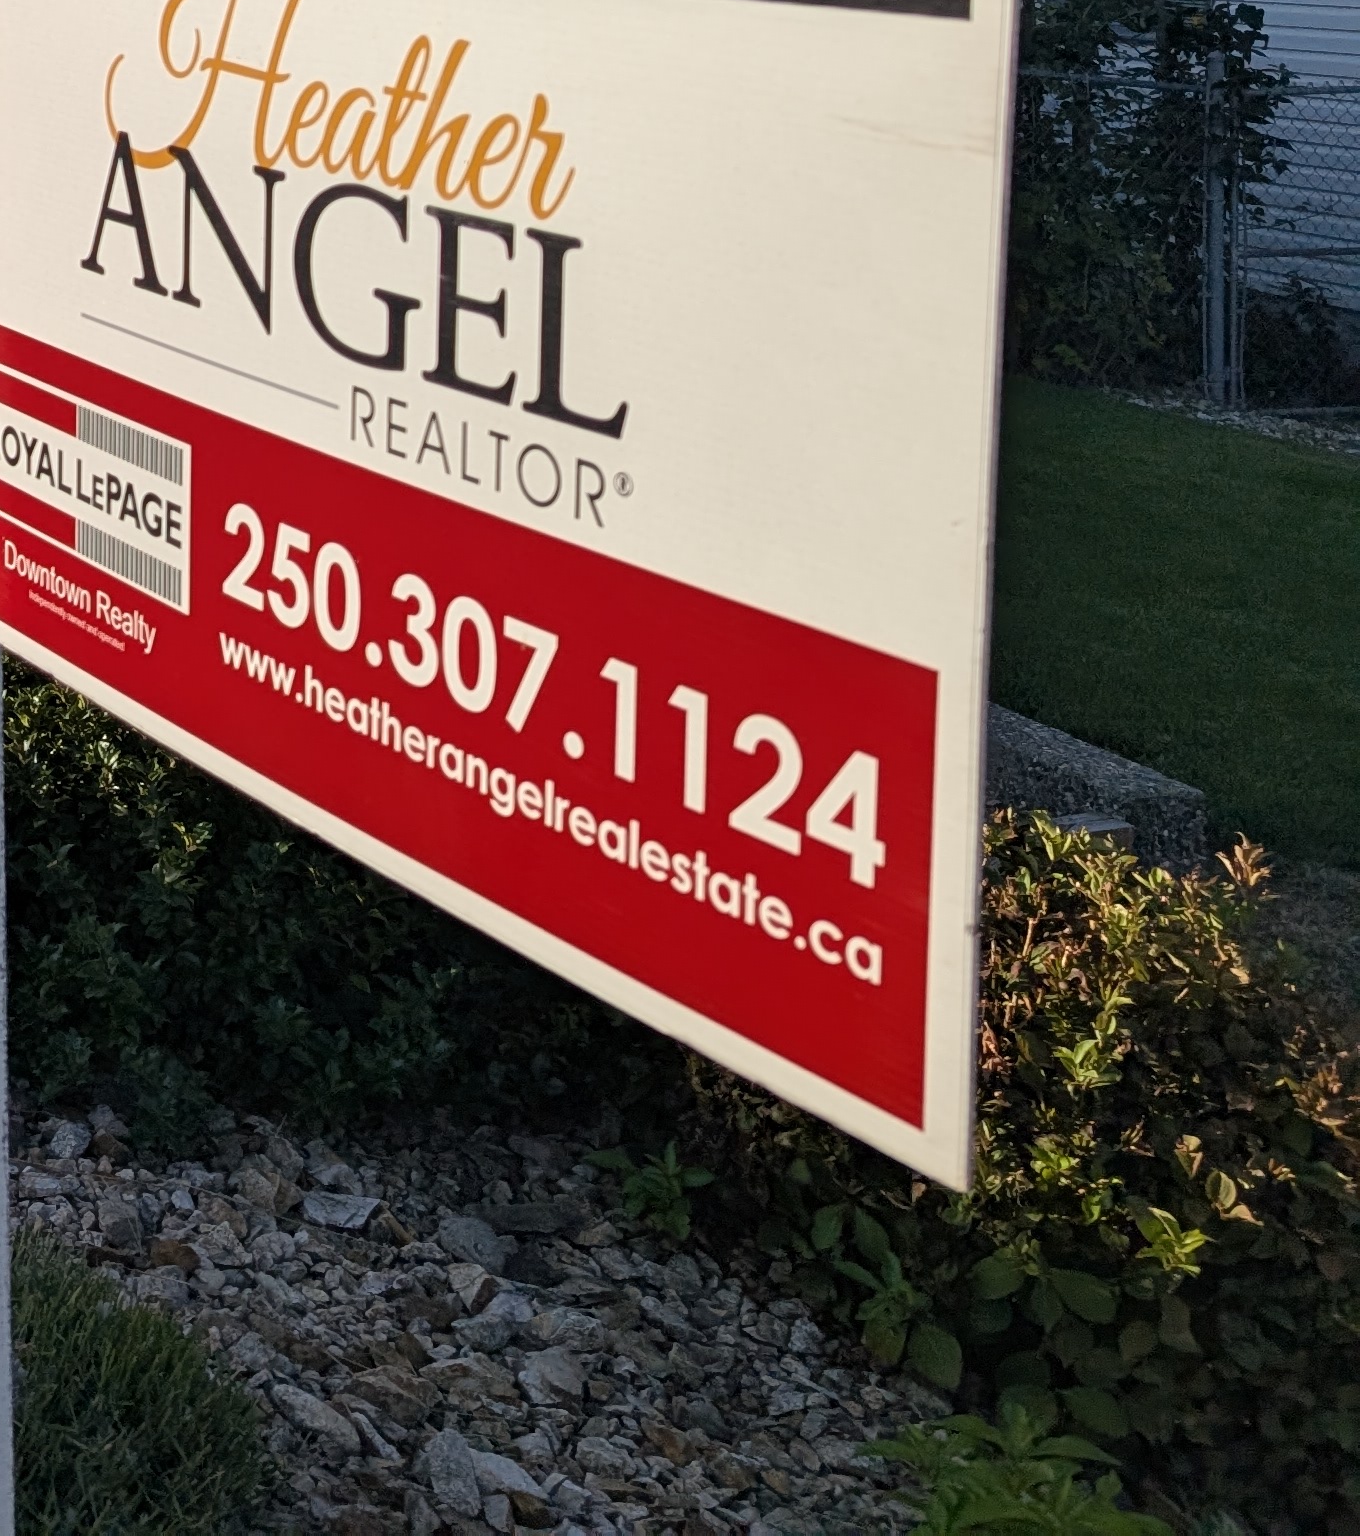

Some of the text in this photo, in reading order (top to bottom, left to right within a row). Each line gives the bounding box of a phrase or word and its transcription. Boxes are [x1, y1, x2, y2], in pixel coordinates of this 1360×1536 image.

[80, 130, 629, 440] ANGEL
[3, 539, 92, 614] Downtown
[95, 589, 157, 656] Realty
[222, 502, 886, 890] 250.307.1124
[218, 632, 884, 986] www.heatherangelrealestate.ca
